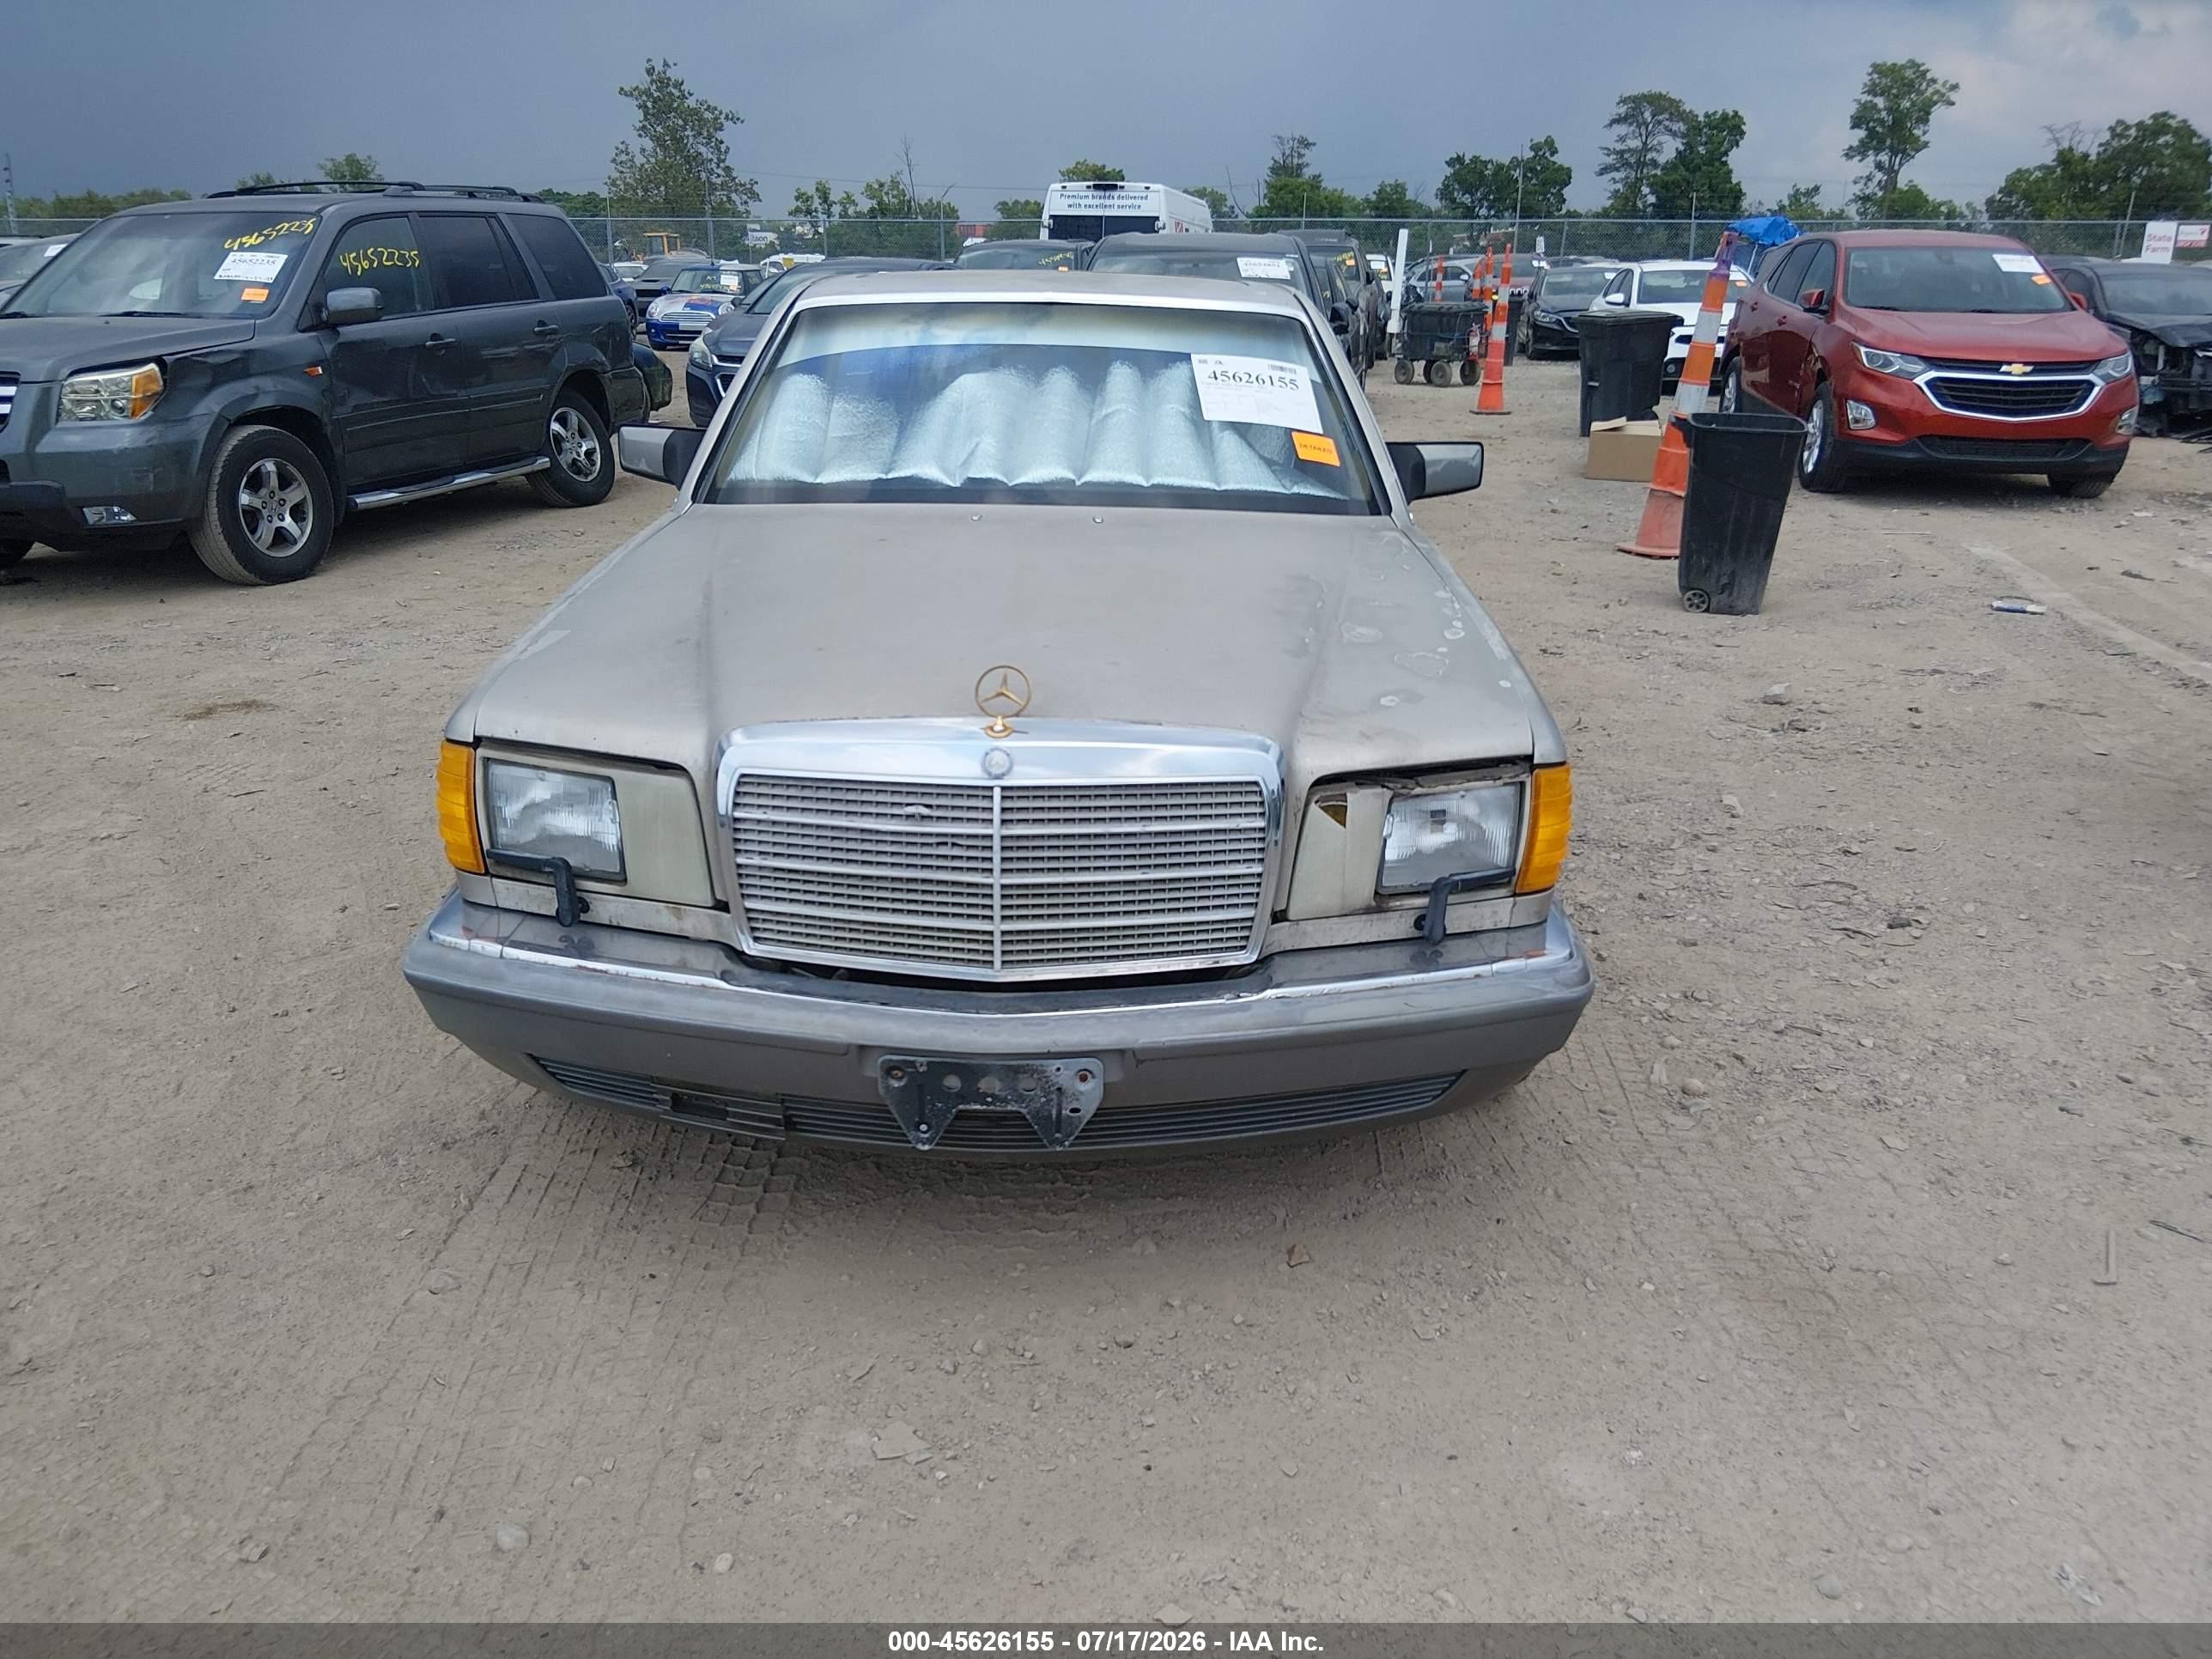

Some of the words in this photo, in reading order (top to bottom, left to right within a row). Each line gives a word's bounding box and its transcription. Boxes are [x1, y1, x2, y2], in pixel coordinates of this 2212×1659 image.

[1060, 192, 1090, 201] Premium
[1091, 192, 1115, 201] brands
[1117, 193, 1149, 202] delivered
[2143, 244, 2171, 254] Farm
[338, 247, 420, 277] 45652235
[1207, 369, 1300, 392] 45626155
